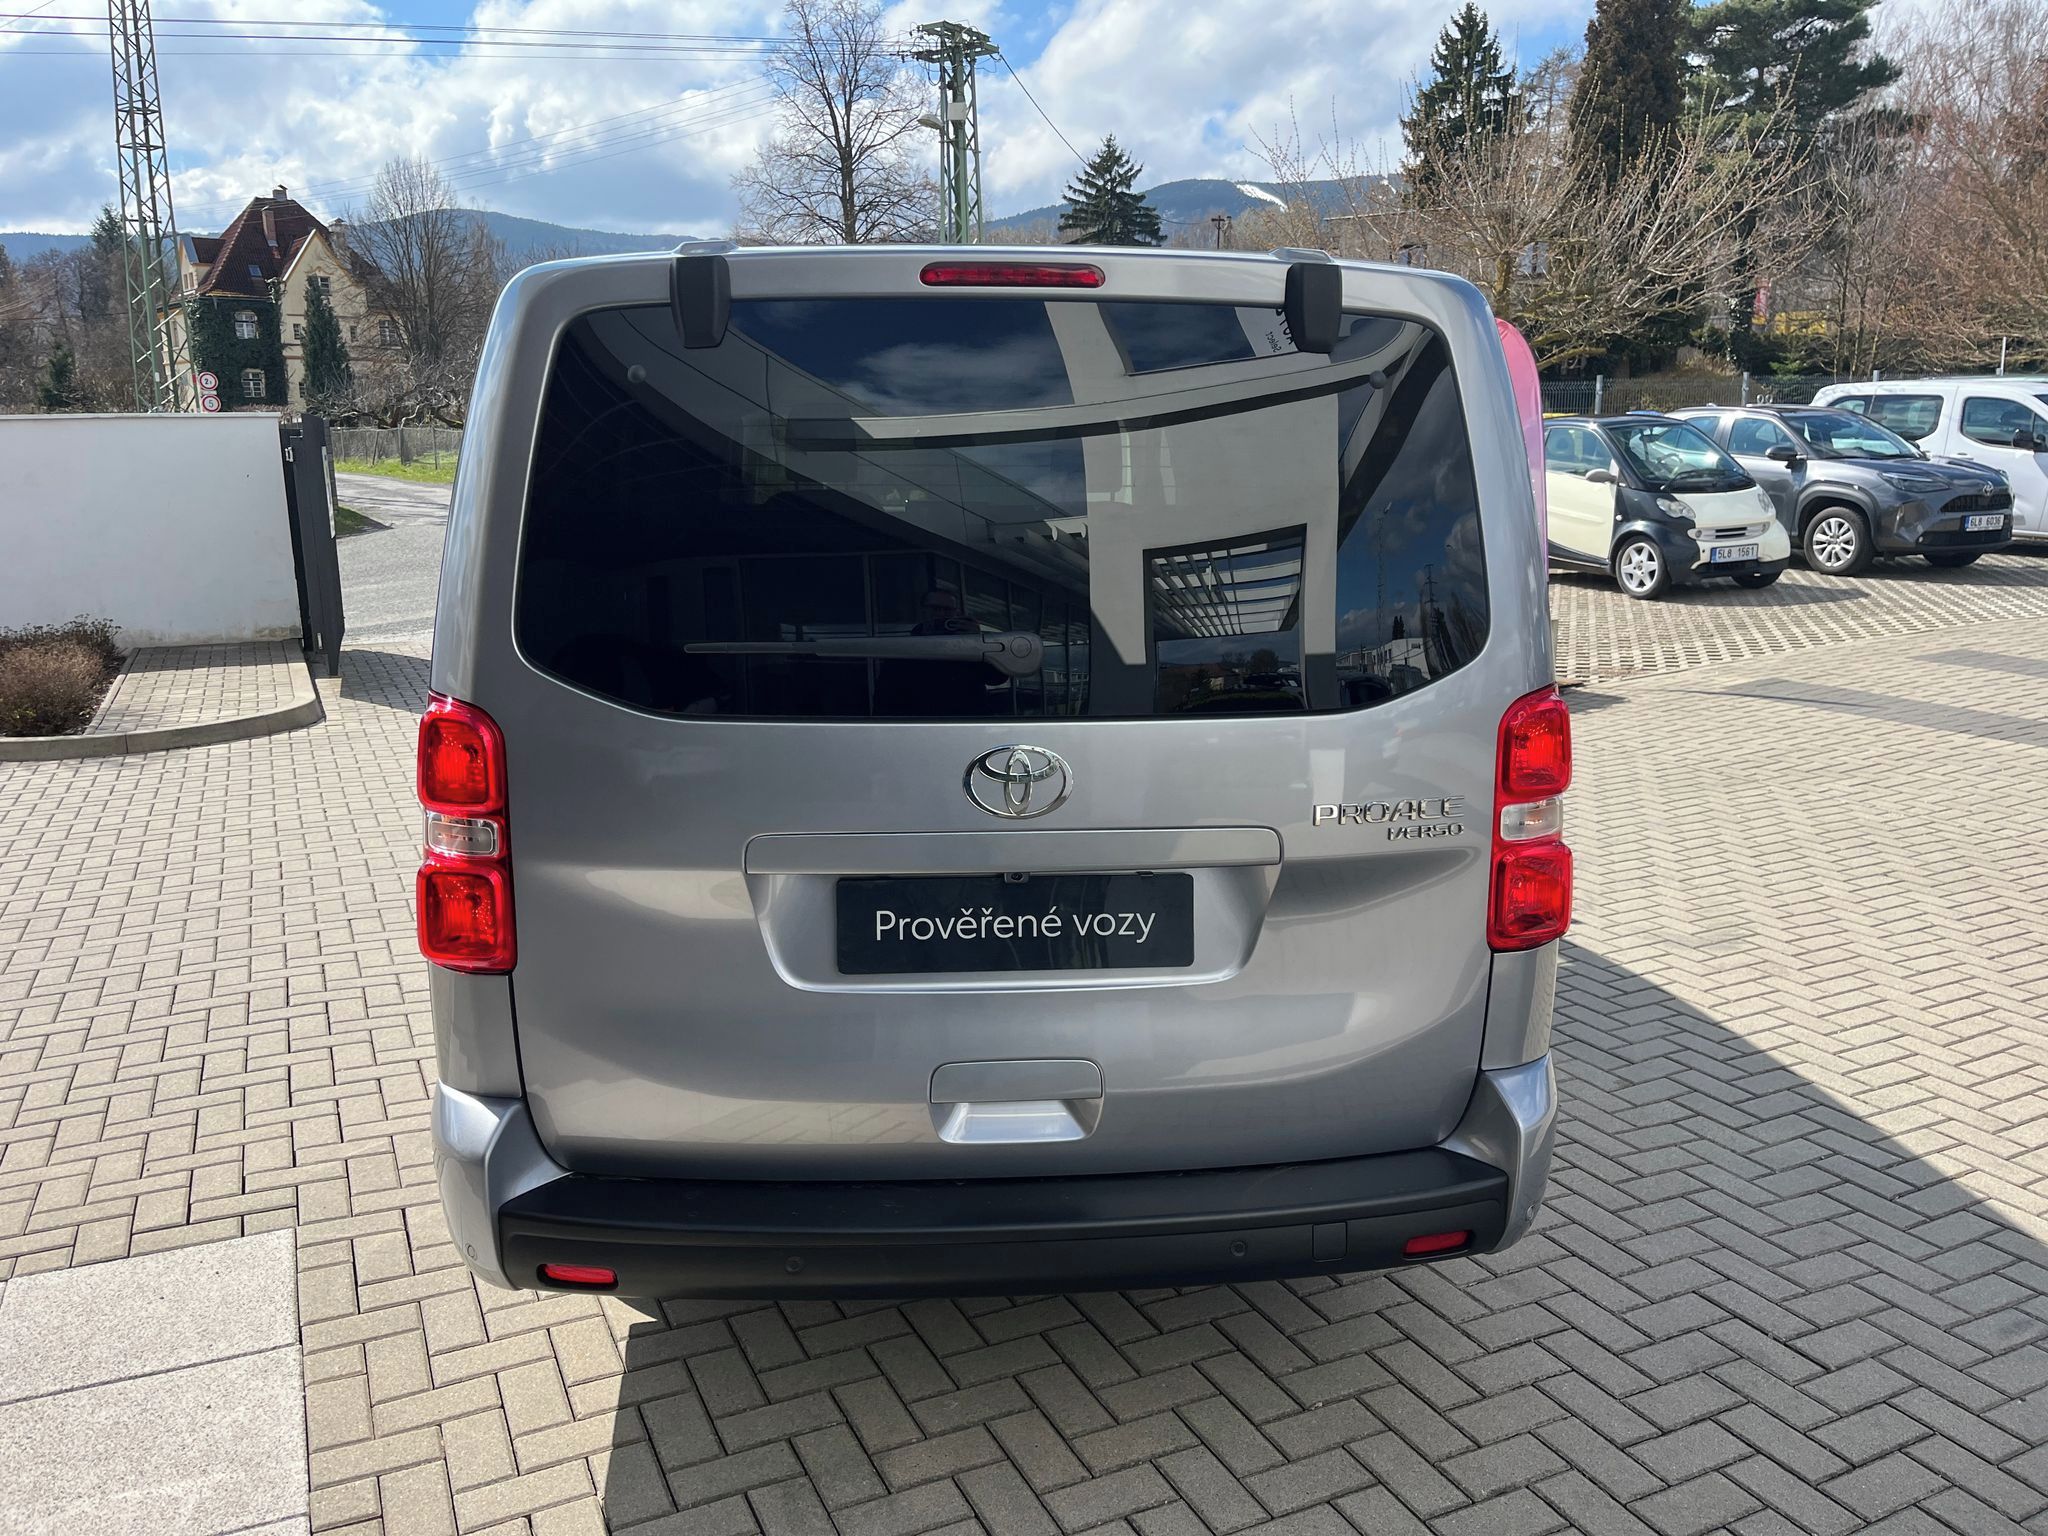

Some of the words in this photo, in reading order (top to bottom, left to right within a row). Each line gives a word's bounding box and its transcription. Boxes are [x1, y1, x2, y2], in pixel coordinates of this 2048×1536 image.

[1717, 548, 1732, 559] 5L8
[1738, 546, 1755, 557] 1561
[1312, 795, 1465, 827] PROACE
[1387, 822, 1464, 840] VERSO
[875, 906, 1062, 941] Prověřené
[1072, 911, 1156, 943] vozy
